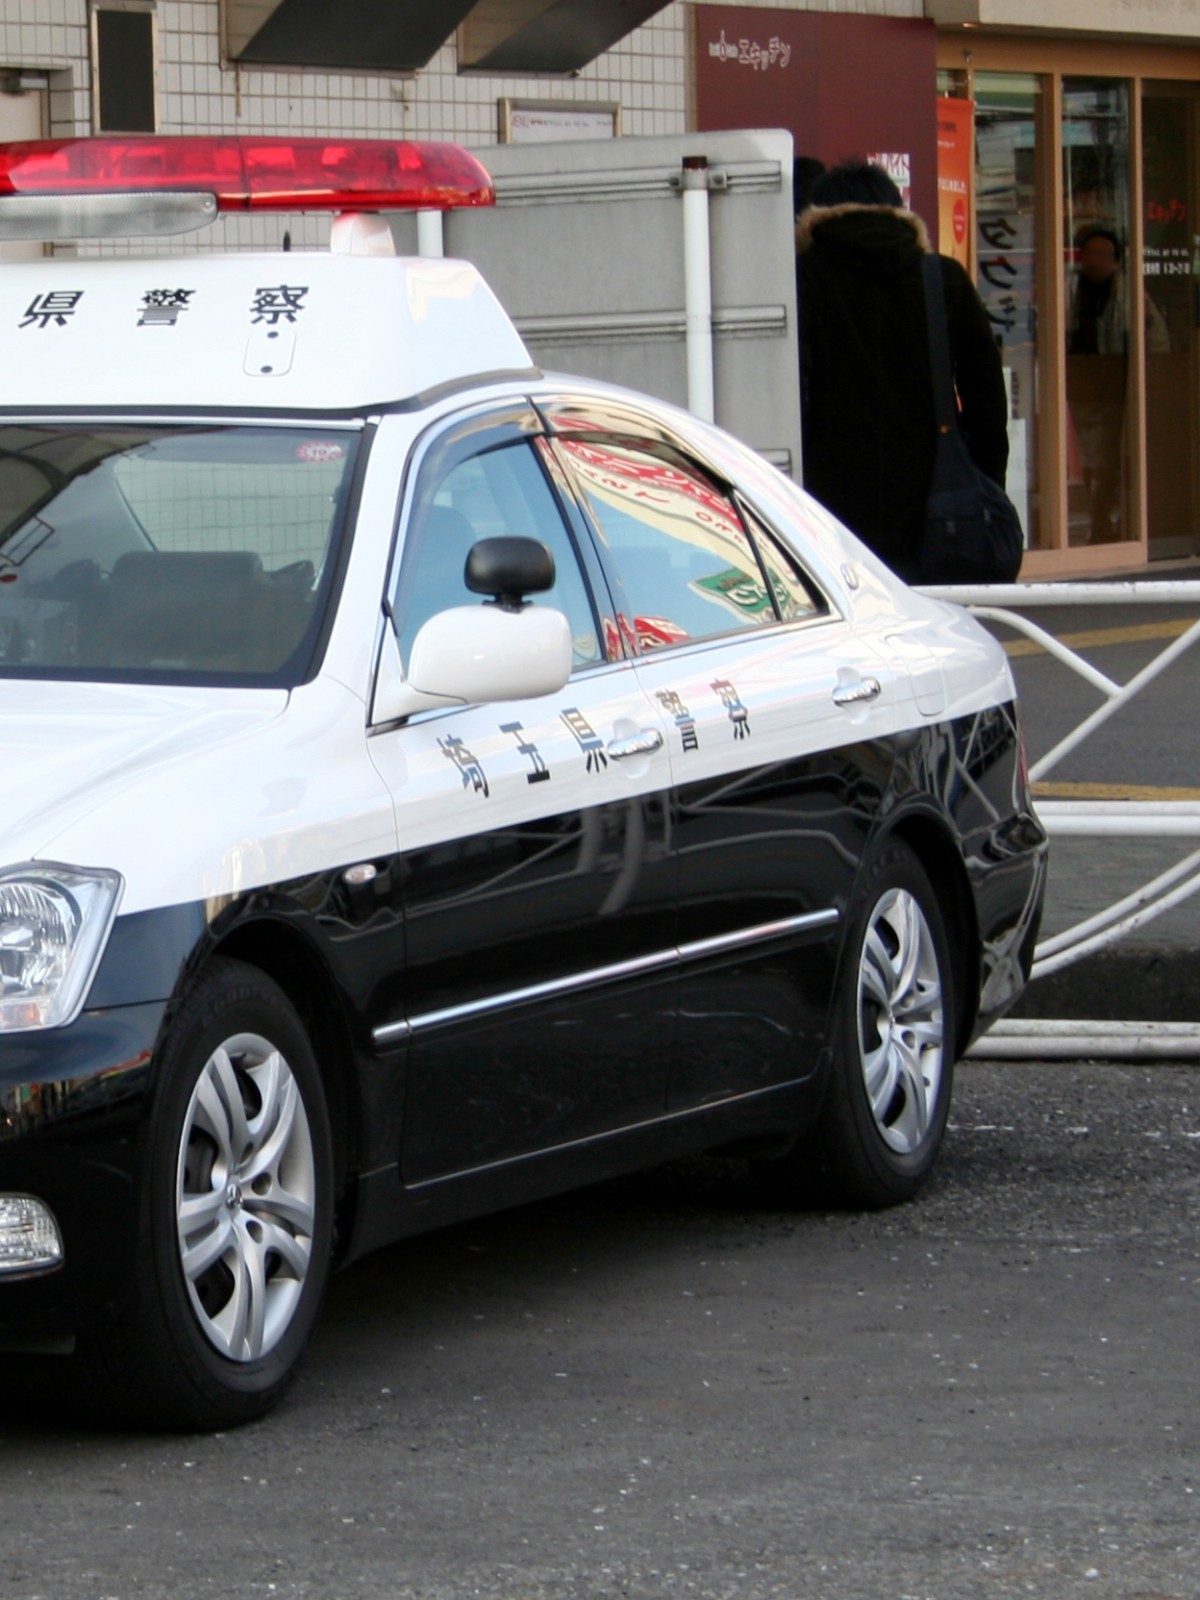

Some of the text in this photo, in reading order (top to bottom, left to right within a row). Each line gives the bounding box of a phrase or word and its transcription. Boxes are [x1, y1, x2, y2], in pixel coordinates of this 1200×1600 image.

[436, 678, 751, 798] 埼玉県警察
